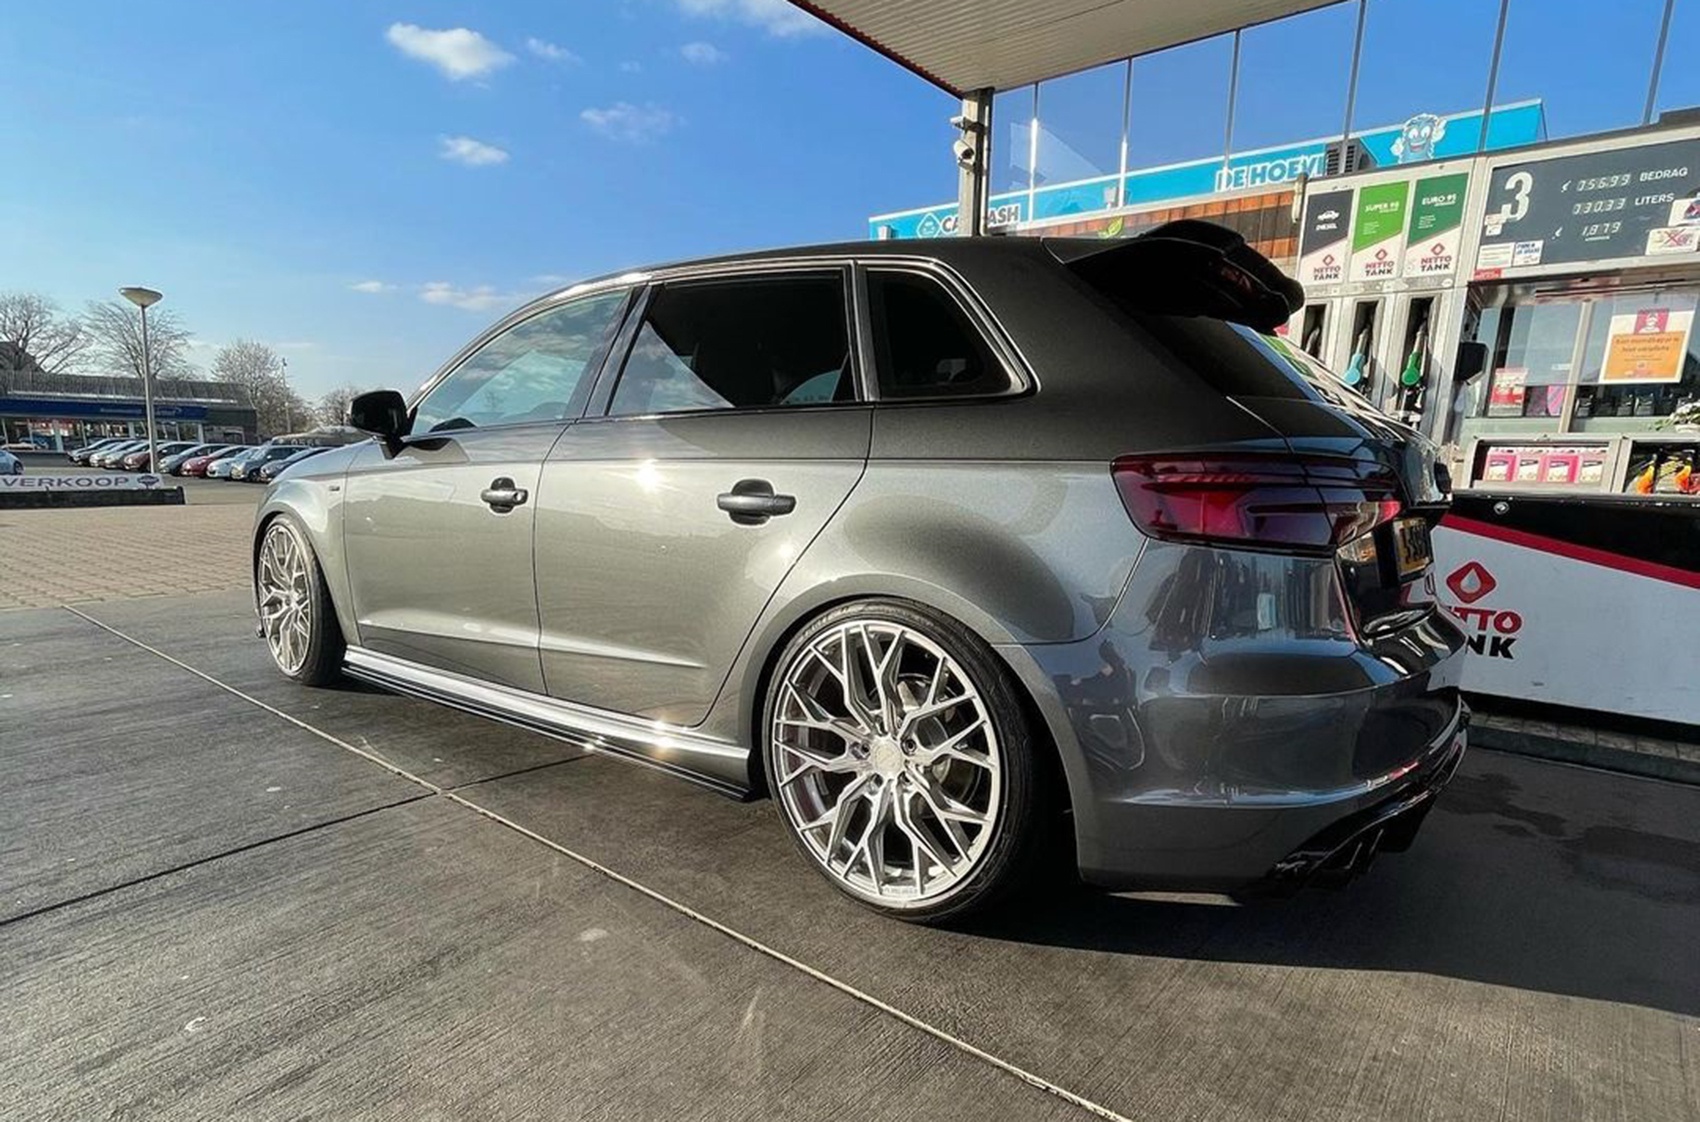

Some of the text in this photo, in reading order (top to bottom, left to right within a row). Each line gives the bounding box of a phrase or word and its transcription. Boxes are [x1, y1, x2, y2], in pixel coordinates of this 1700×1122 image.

[1217, 167, 1246, 191] DE
[1640, 167, 1688, 181] BEDRAG
[1501, 171, 1533, 221] 3
[1634, 193, 1675, 206] LITERS
[1364, 260, 1395, 269] NETTO
[1420, 255, 1452, 264] NETTO
[1313, 265, 1341, 274] NETTO
[1364, 267, 1393, 277] TANK
[1420, 263, 1450, 272] TANK
[1313, 273, 1339, 281] TANK
[3, 476, 130, 488] VERKOOP
[1448, 606, 1523, 634] TTO
[1465, 633, 1517, 660] NK
